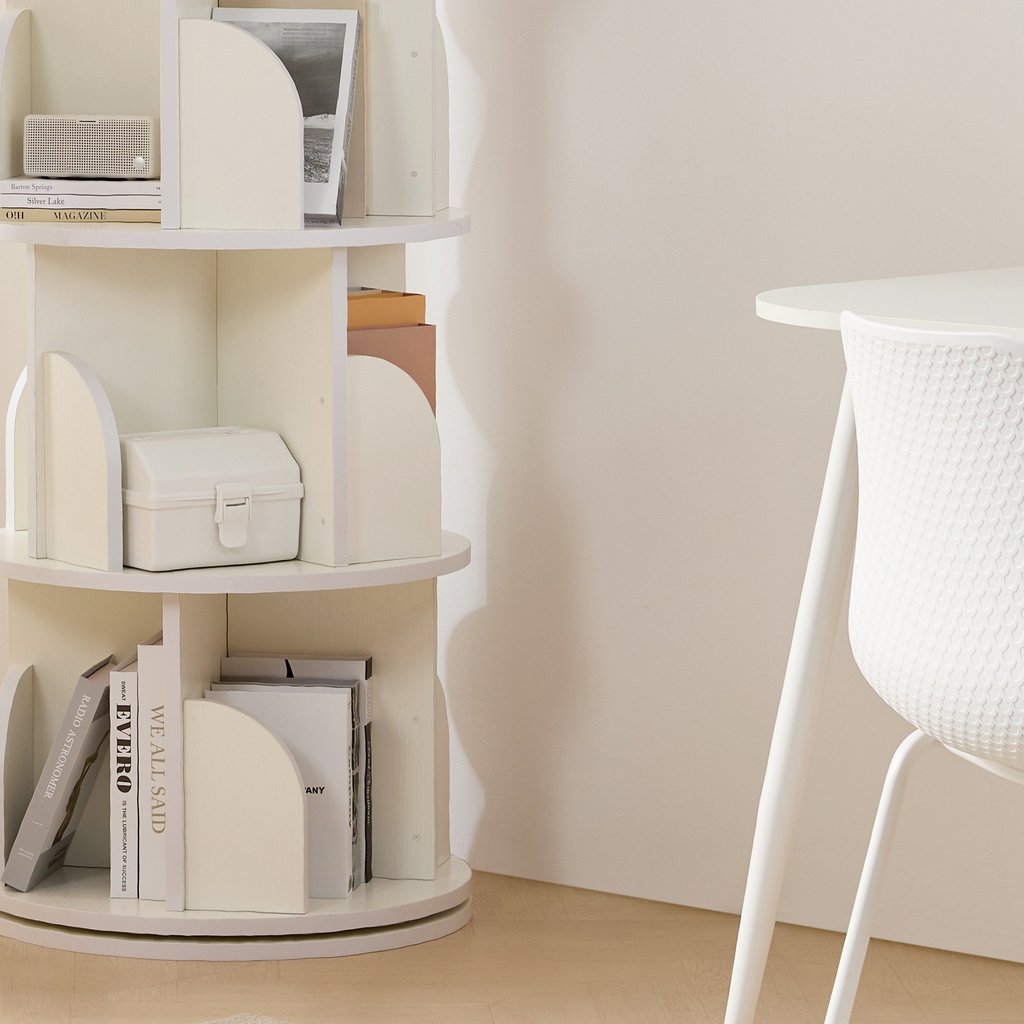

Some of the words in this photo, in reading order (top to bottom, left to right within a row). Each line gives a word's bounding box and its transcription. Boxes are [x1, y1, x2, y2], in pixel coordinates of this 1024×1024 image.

[26, 197, 46, 205] Silver
[47, 197, 65, 205] Lake
[31, 183, 53, 192] Springs
[53, 211, 107, 220] MAGAZINE
[72, 694, 91, 728] RADIO
[150, 705, 165, 737] WE
[43, 730, 77, 799] ASTRONOMER
[116, 703, 132, 793] EVERO
[151, 742, 166, 781] ALL
[151, 786, 166, 834] SAID
